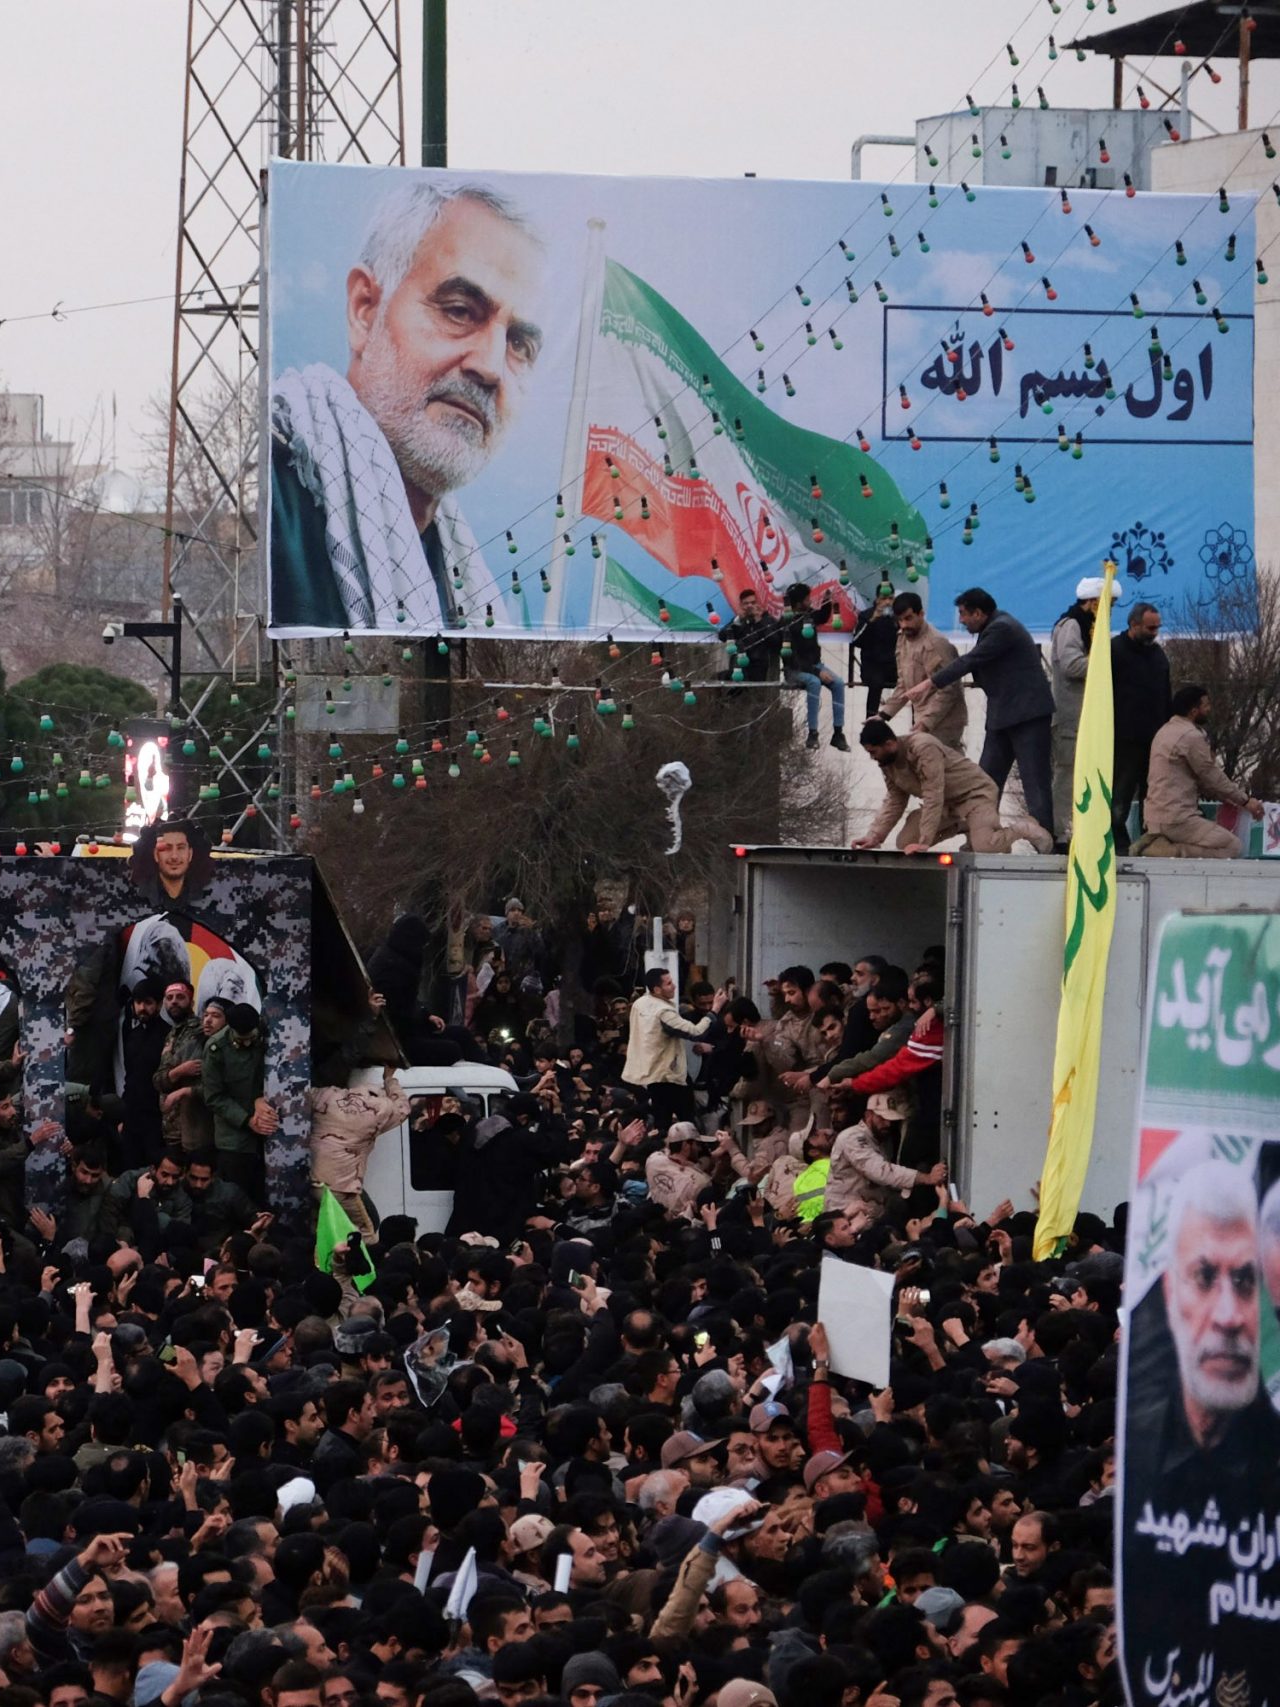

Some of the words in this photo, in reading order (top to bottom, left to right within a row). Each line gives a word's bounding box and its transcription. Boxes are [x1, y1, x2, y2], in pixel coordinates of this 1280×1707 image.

[920, 320, 1004, 397] الله
[1019, 357, 1108, 419] بسم
[1125, 341, 1213, 421] اول
[1135, 1500, 1228, 1556] شهید
